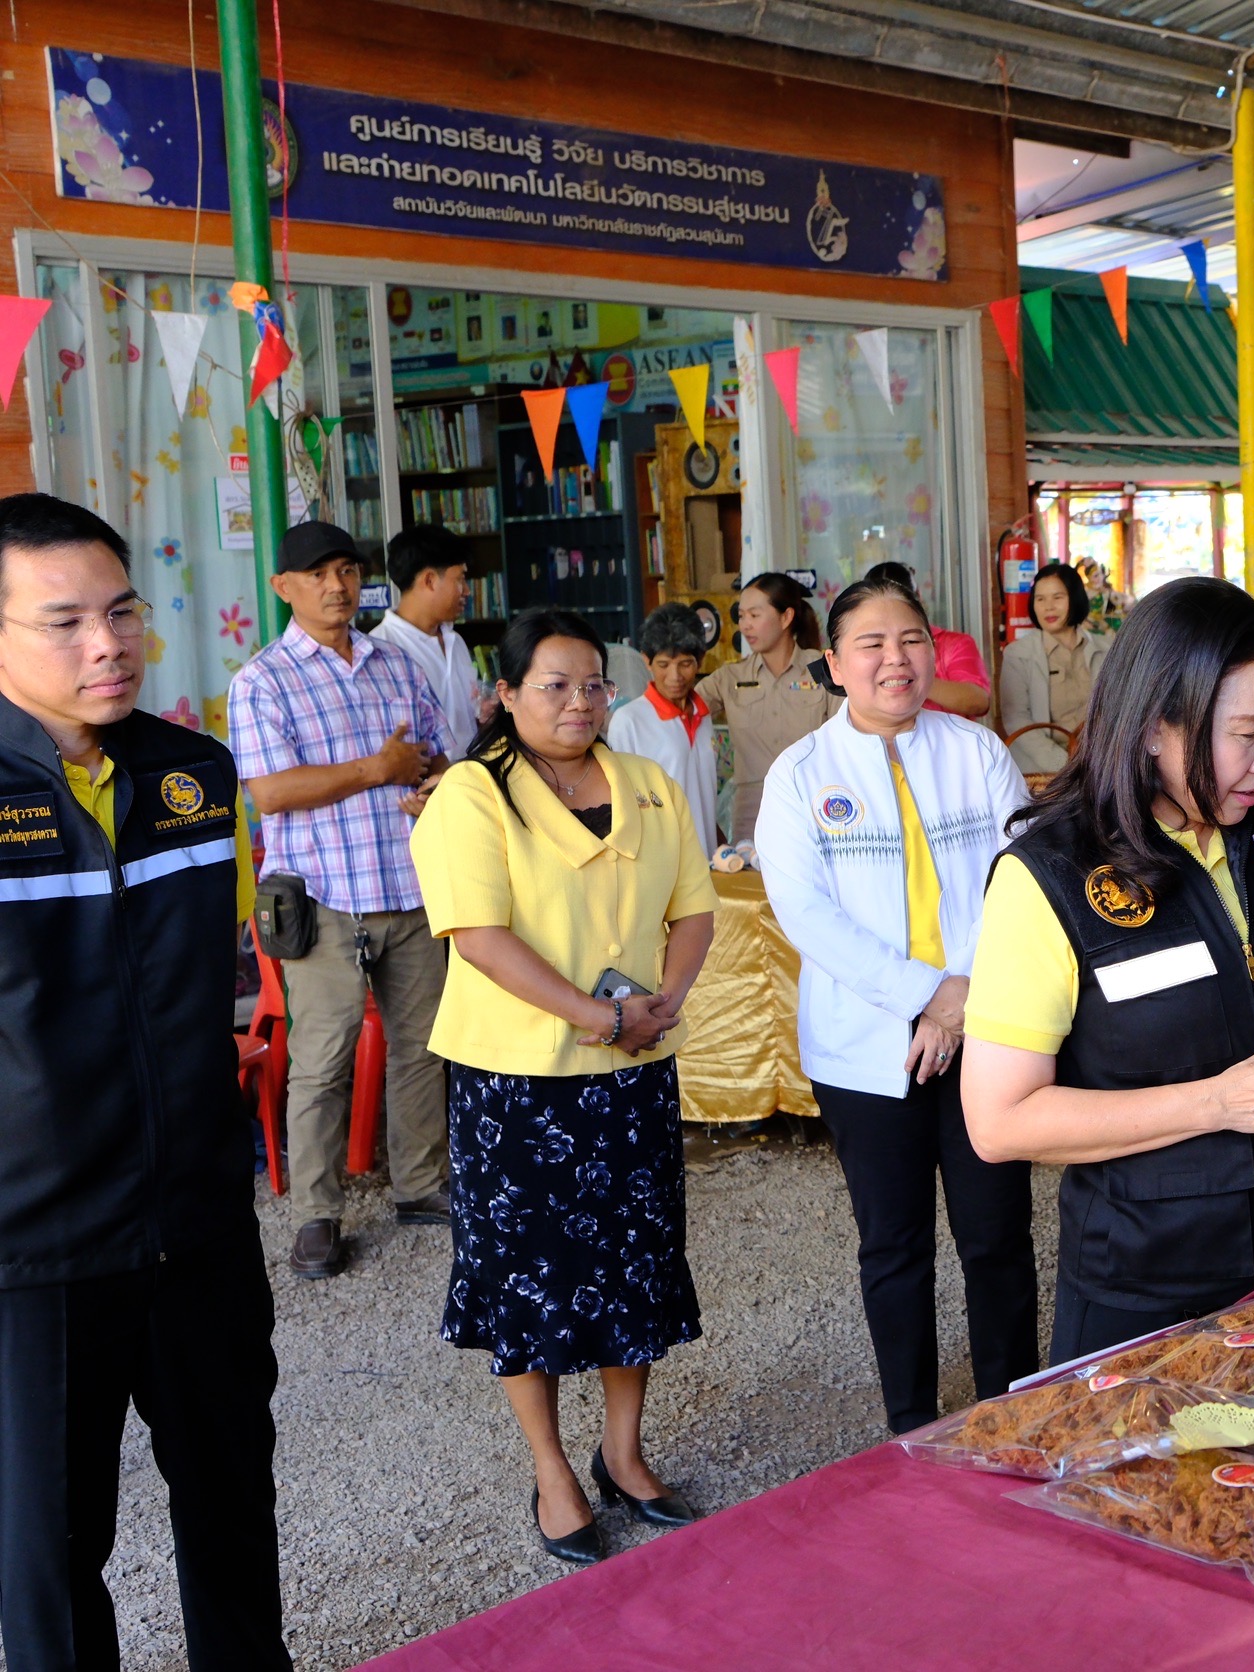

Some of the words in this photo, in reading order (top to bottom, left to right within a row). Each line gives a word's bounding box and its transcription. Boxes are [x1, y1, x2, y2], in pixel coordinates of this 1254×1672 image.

[350, 114, 542, 164] ศูนย์การเรียนรู้
[552, 139, 603, 166] วิจัย
[614, 150, 766, 187] บริการวิชาการ
[323, 151, 790, 225] และถ่ายทอดเทคโนโลยีนวัตกรรมสู่ชุมชน
[392, 196, 547, 226] สถาบันวิจัยและพัฒนา
[639, 346, 713, 375] ASEAN
[0, 805, 51, 824] ษ์สุวรรณ
[155, 804, 230, 830] กระทรวงมหาดไทย
